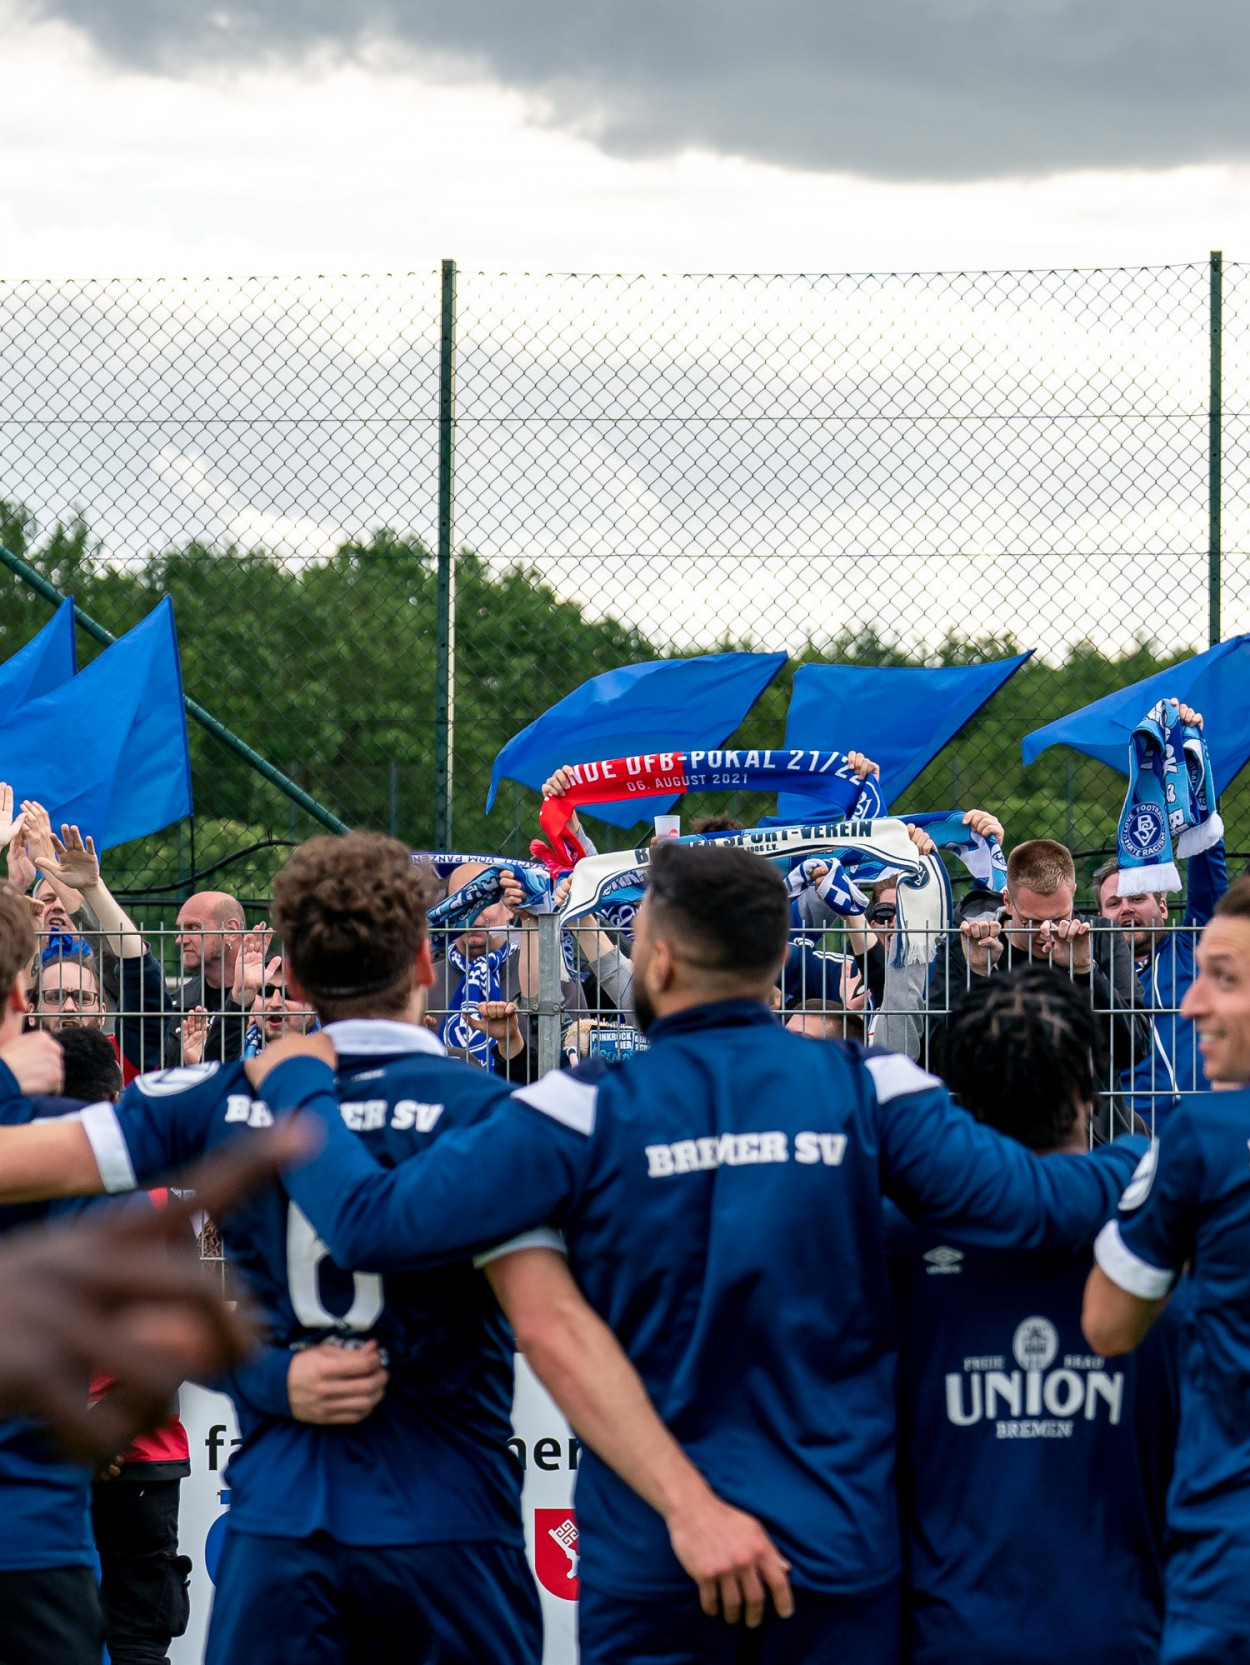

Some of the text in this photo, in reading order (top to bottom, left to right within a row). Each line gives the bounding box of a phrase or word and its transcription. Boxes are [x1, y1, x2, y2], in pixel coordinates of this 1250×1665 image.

[626, 773, 748, 792] 06. AUGUST 2021
[391, 1100, 444, 1133] SV
[645, 1130, 848, 1178] BREMER SV
[946, 1368, 1124, 1426] UNION
[995, 1421, 1073, 1439] BREMEN
